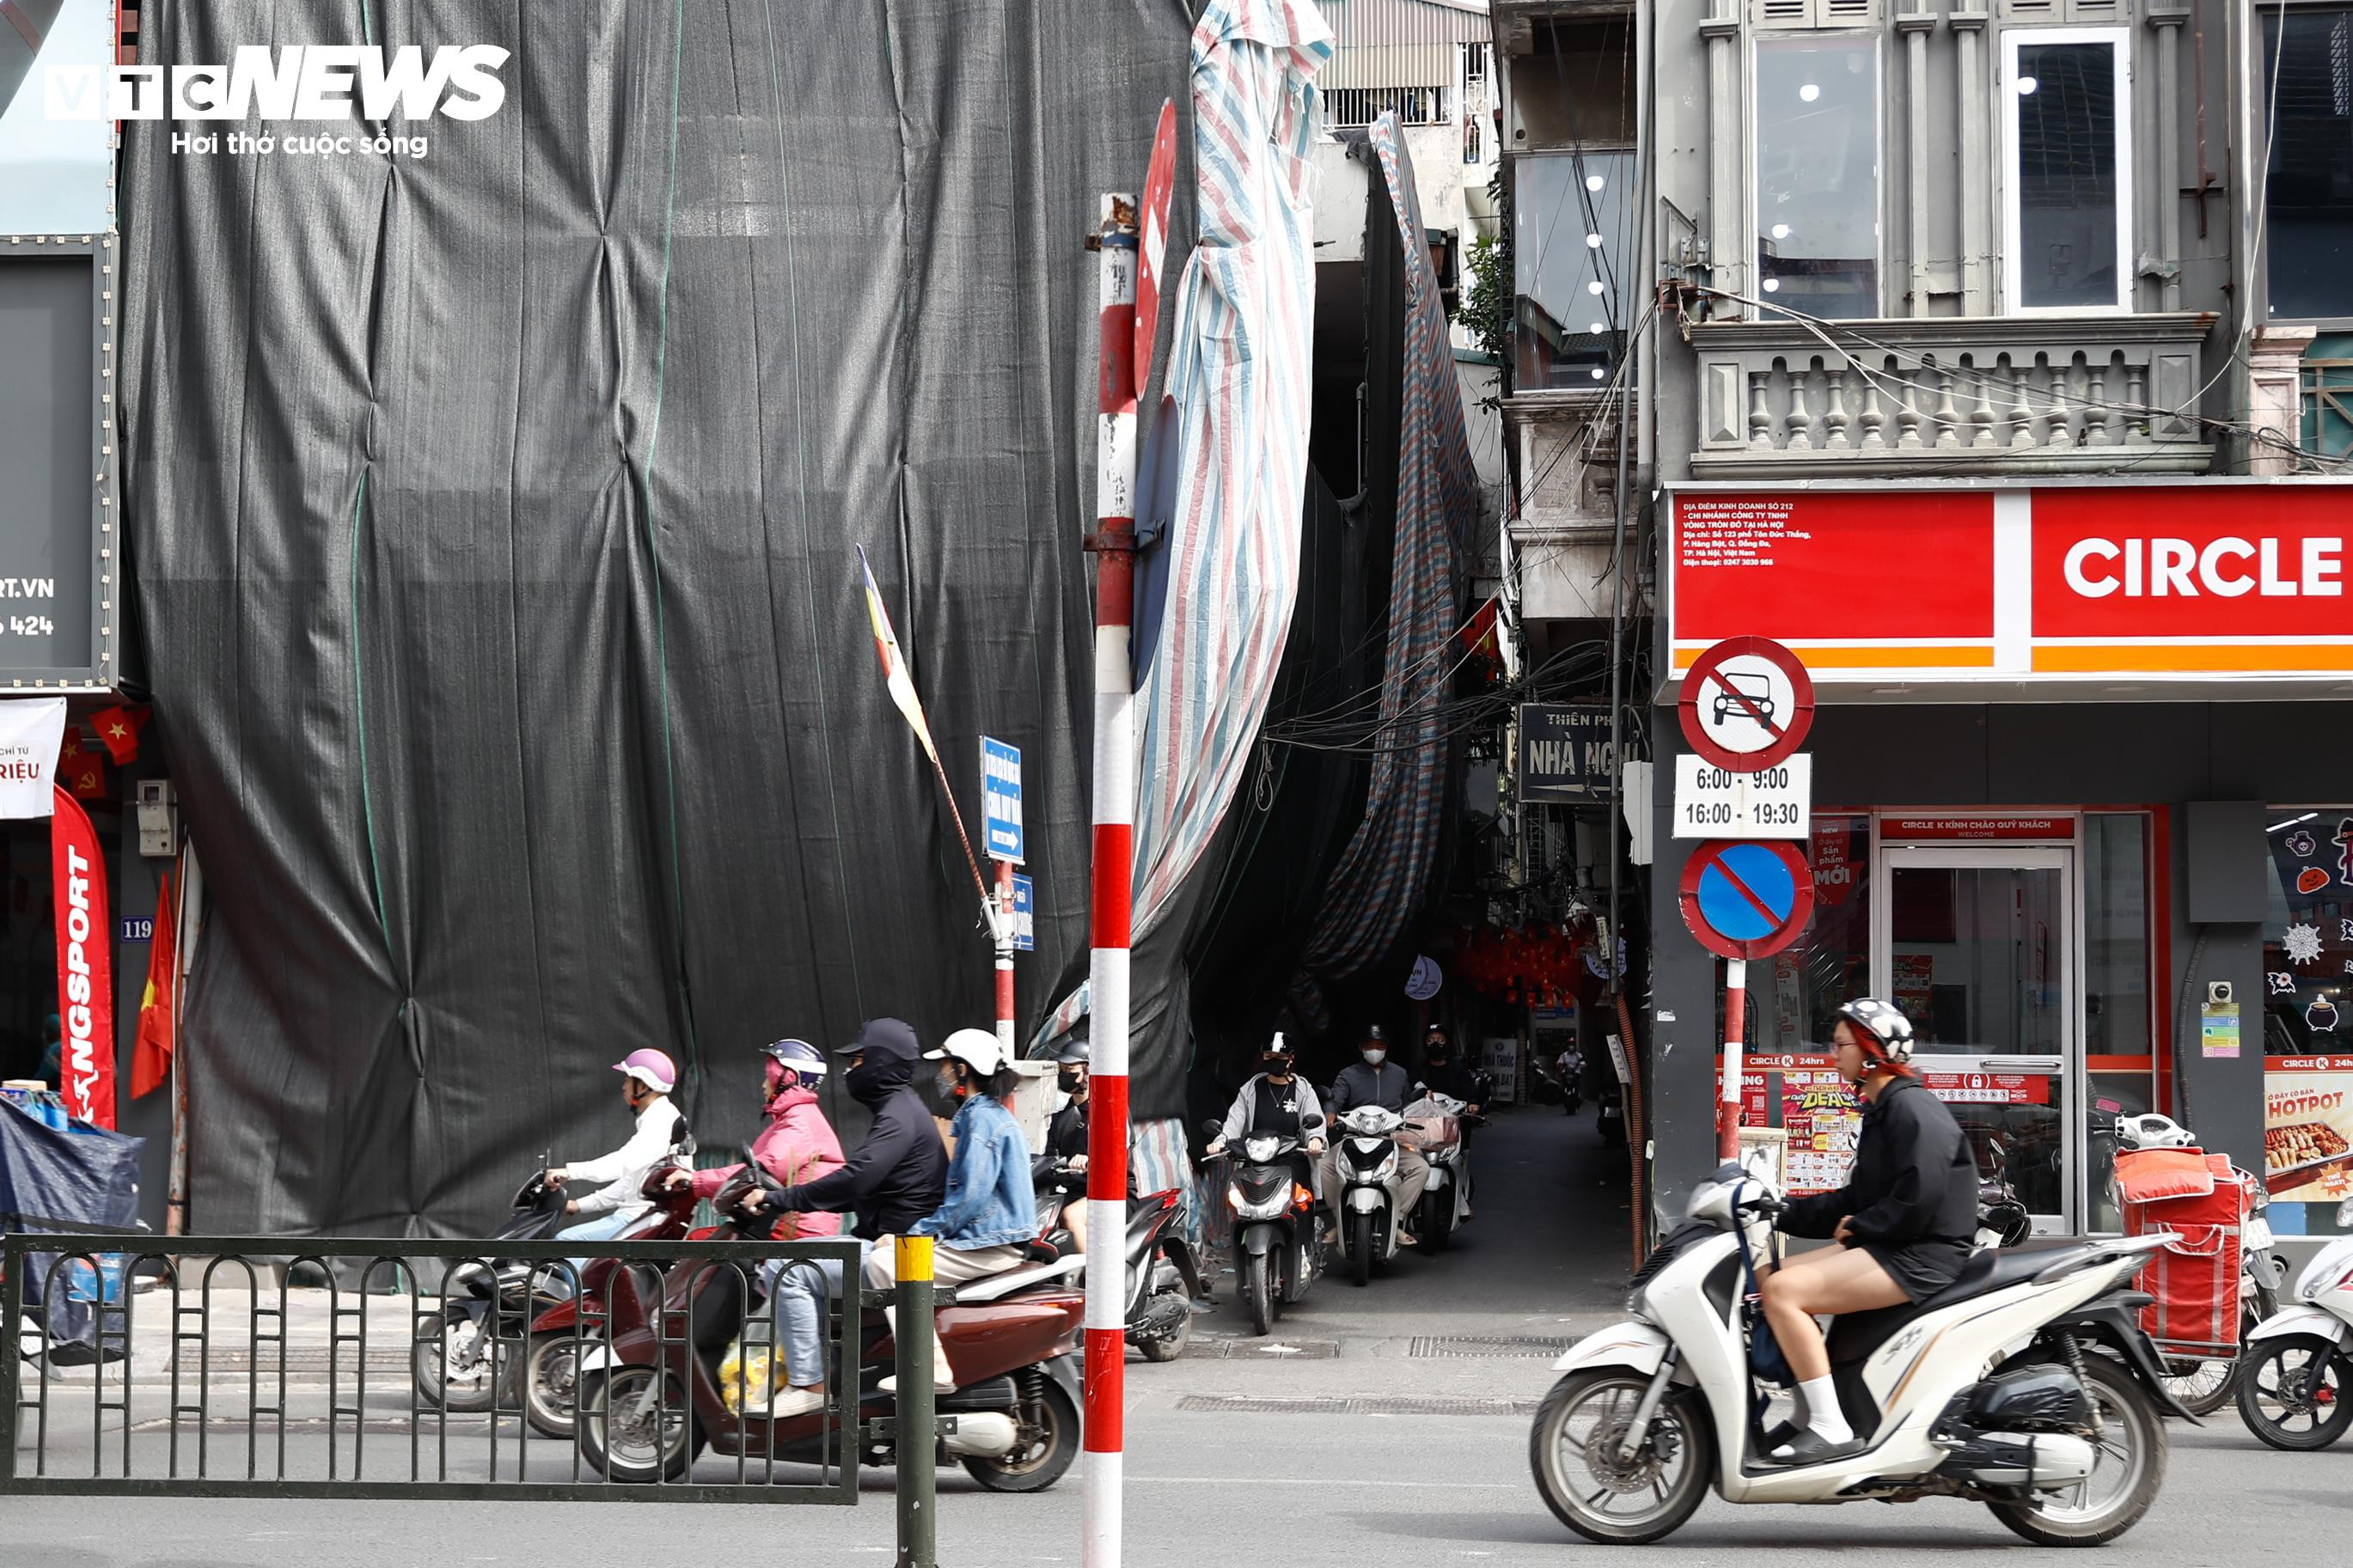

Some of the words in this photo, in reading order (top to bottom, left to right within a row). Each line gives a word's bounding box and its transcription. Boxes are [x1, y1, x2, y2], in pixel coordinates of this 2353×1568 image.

[1702, 510, 1730, 519] NHÁNH
[2063, 537, 2342, 598] CIRCLE
[10, 615, 54, 636] 424
[1547, 711, 1589, 726] THIÊN
[1530, 731, 1576, 775] NHÀ
[1697, 768, 1732, 789] 6:00
[1753, 768, 1788, 789] 9:00
[1686, 803, 1731, 824] 16:00
[1753, 803, 1798, 824] 19:30
[1946, 820, 1968, 828] KÍNH
[1969, 820, 1995, 828] CHÀO
[2019, 819, 2051, 828] KHÁCH
[1823, 845, 1838, 855] Sản
[1814, 864, 1849, 886] MỚI
[124, 921, 152, 938] 119
[1782, 1055, 1794, 1067] K
[2315, 1057, 2329, 1069] K
[1801, 1091, 1850, 1109] DEAL
[2269, 1092, 2344, 1120] HOTPOT
